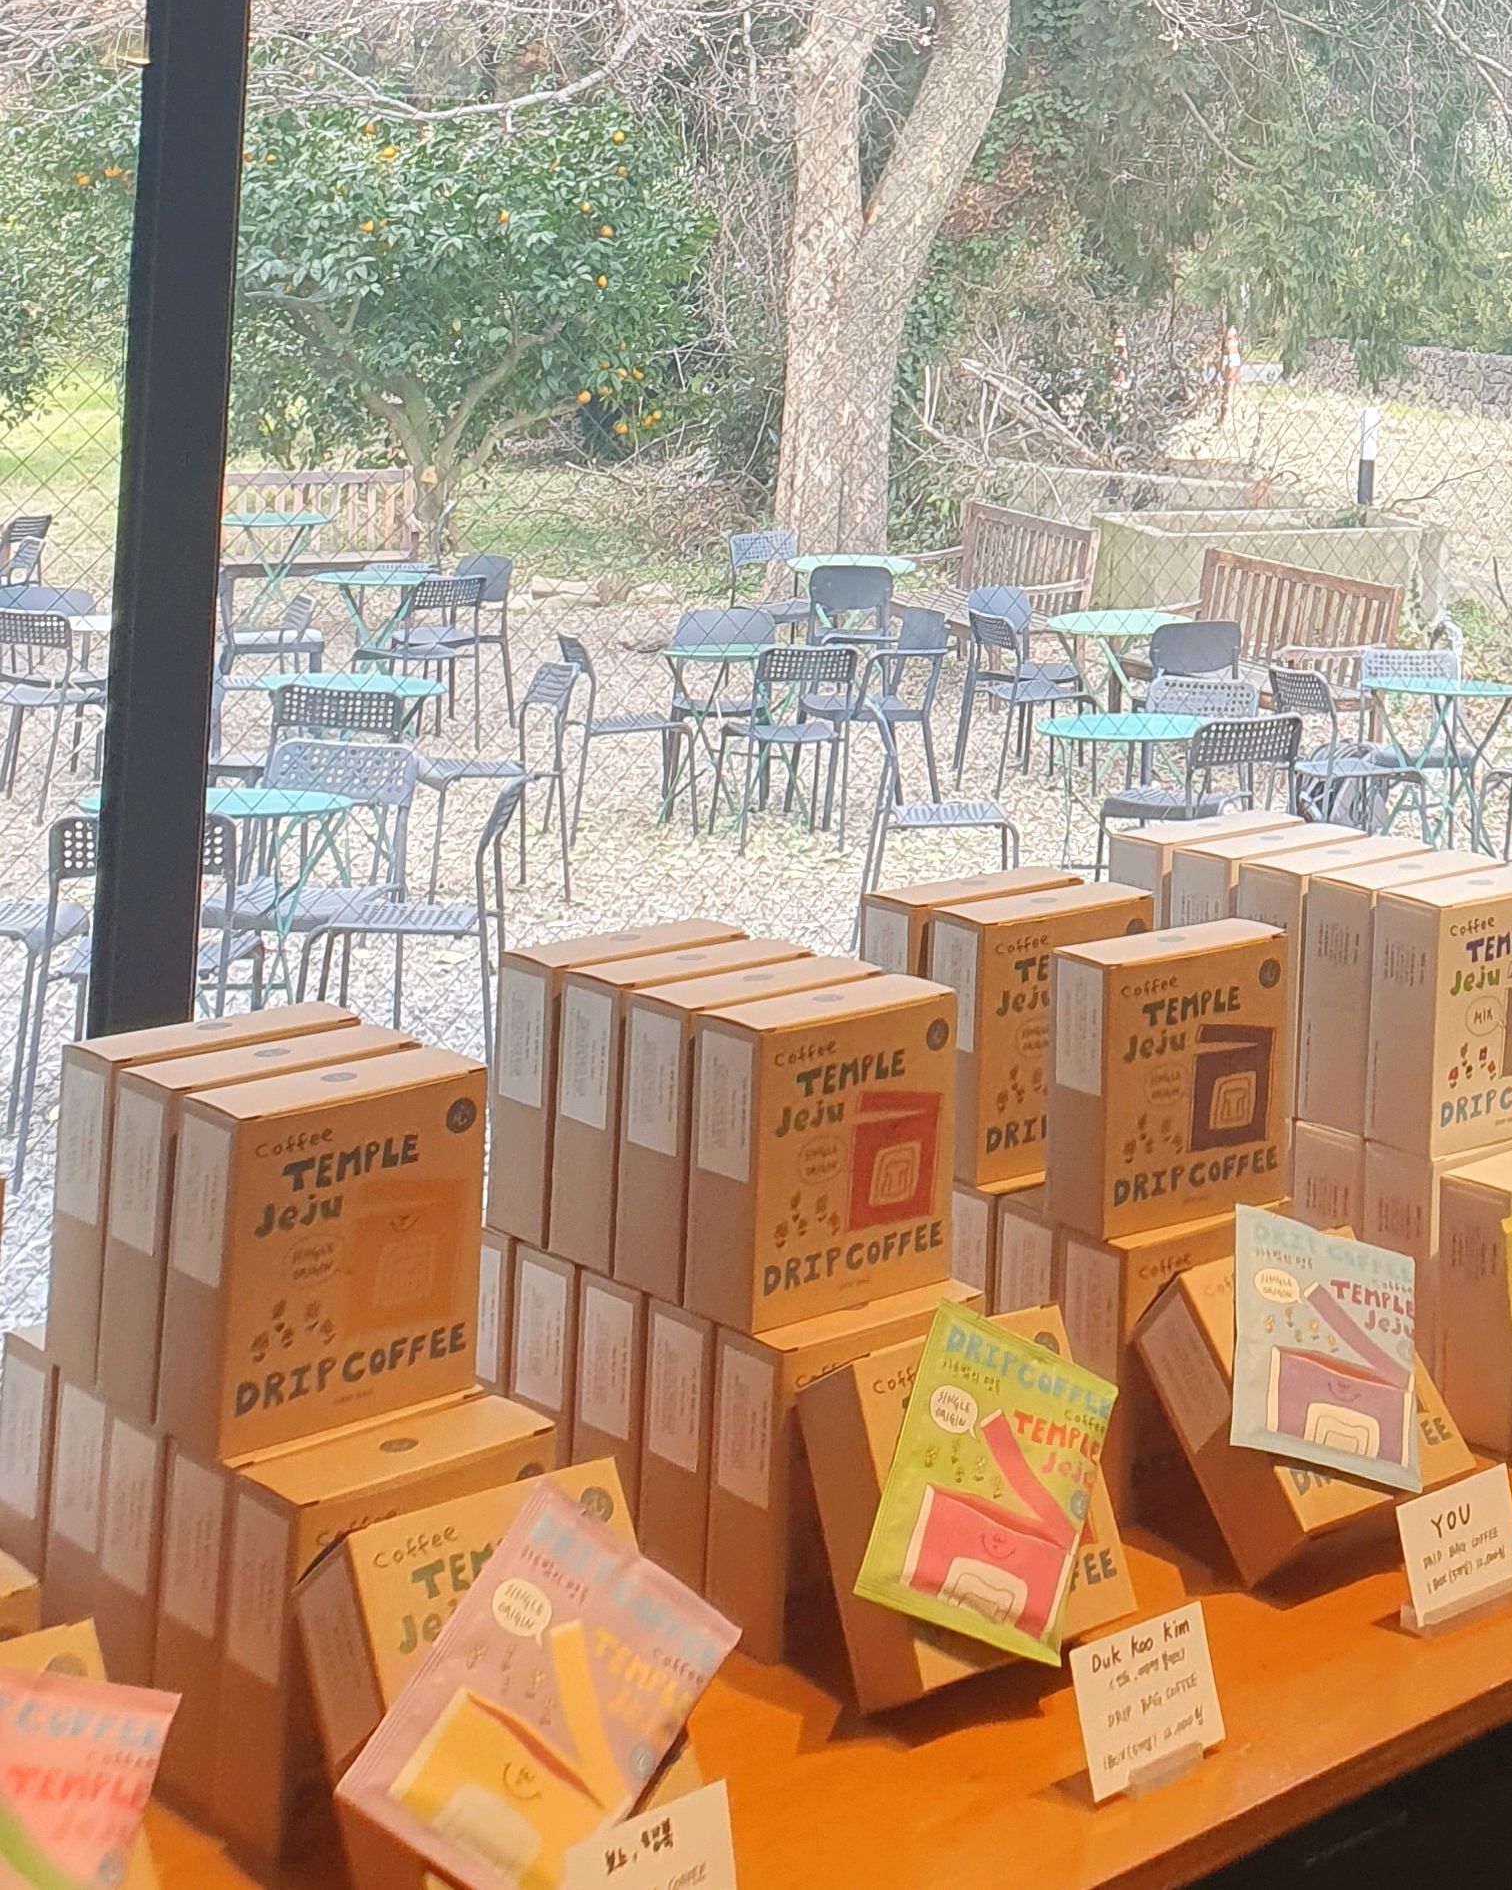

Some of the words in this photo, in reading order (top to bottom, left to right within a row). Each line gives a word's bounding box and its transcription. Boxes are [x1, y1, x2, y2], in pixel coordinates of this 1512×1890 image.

[1450, 916, 1496, 938] Coffee
[994, 934, 1048, 956] Coffee
[1120, 975, 1178, 998] Coffee
[1449, 965, 1500, 996] Jeju
[1142, 985, 1241, 1027] TEMPLE
[1473, 1008, 1493, 1024] MIX
[775, 1040, 838, 1067] Coffee
[1122, 1028, 1186, 1063] Jeju
[796, 1049, 906, 1097] TEMPLE
[774, 1099, 845, 1138] Jeju
[256, 1127, 333, 1158] Coffee
[282, 1134, 419, 1192] TEMPLE
[254, 1193, 344, 1238] Jeju
[1330, 1279, 1415, 1321] TEMPLE
[935, 1407, 967, 1428] ORIGIN
[936, 1390, 971, 1413] SINGLE
[1013, 1410, 1100, 1465] TEMPLE
[1430, 1502, 1470, 1539] YOU
[373, 1523, 458, 1569] Coffee
[1092, 1645, 1122, 1673] Duk
